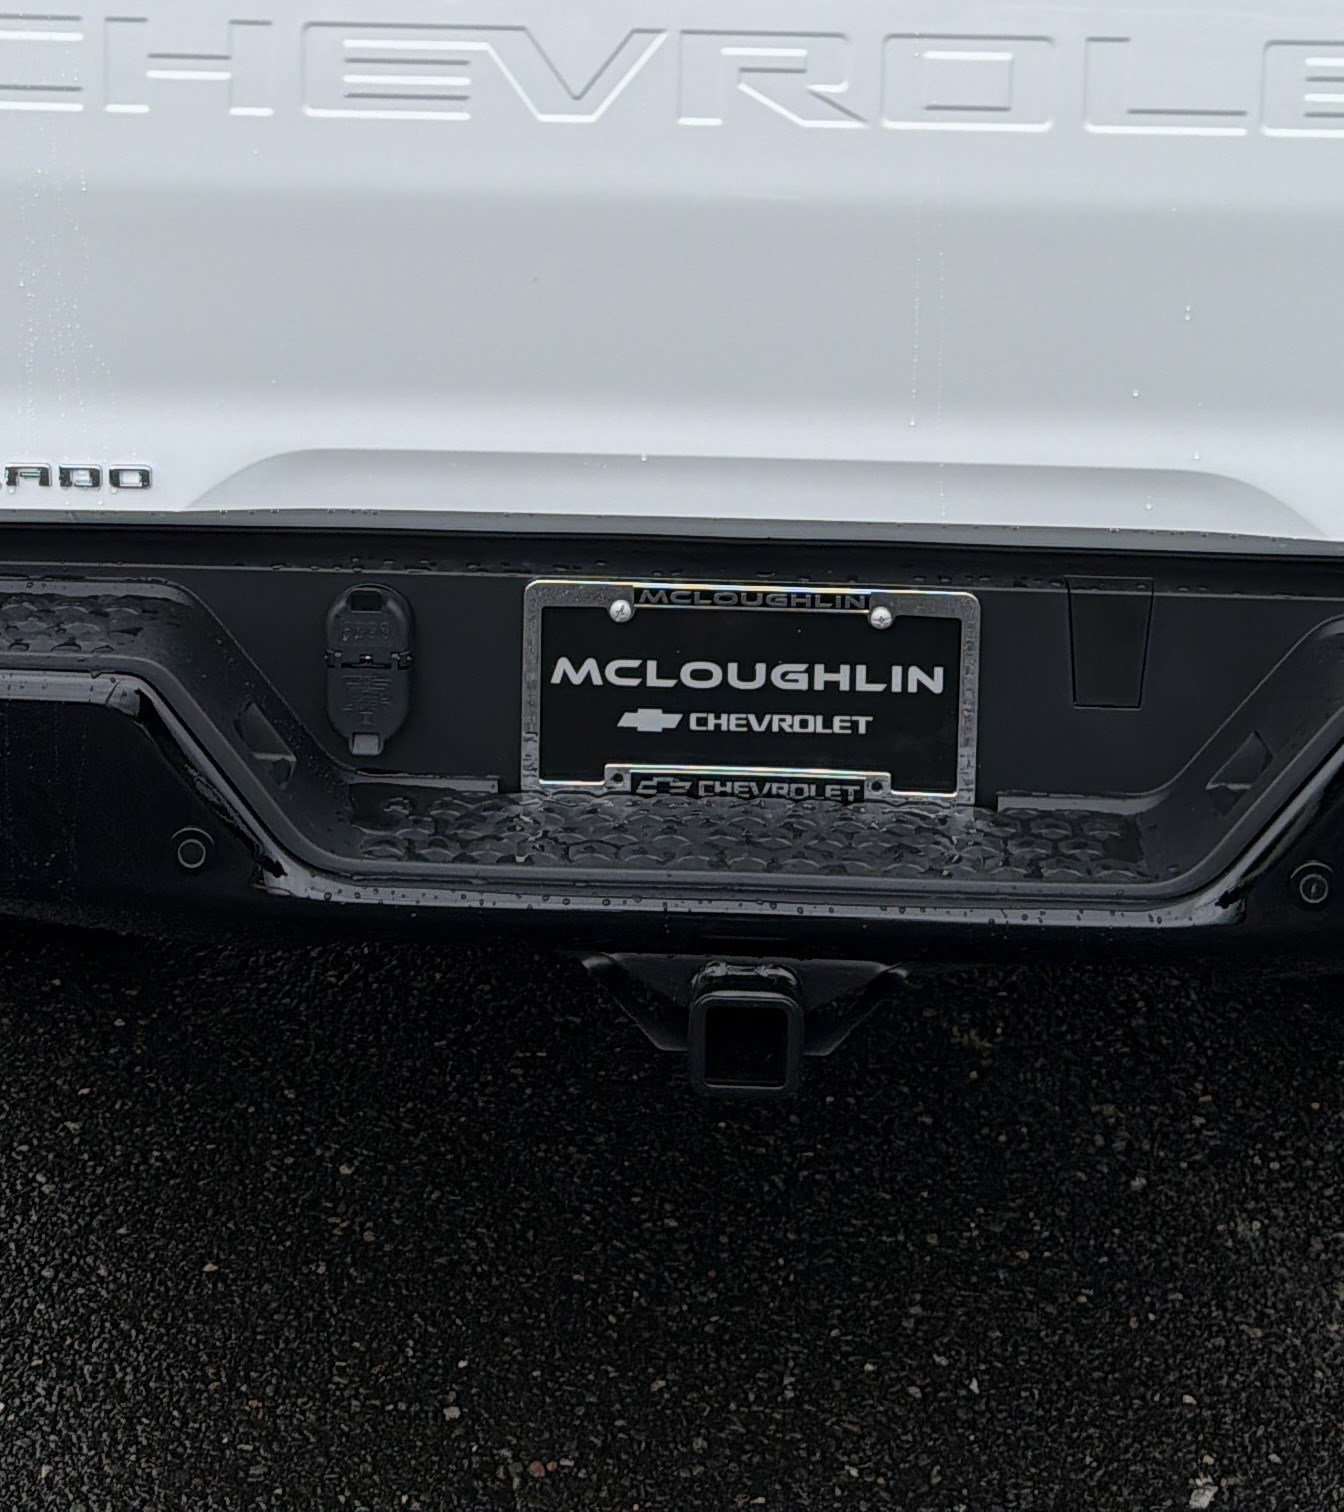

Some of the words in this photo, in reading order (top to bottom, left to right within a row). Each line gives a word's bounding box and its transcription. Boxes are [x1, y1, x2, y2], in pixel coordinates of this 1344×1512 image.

[638, 589, 866, 609] MCLOUGHLIN
[550, 656, 945, 695] MCLOUGHLIN
[688, 712, 873, 735] CHEVROLET
[698, 780, 861, 802] CHEVROLET
